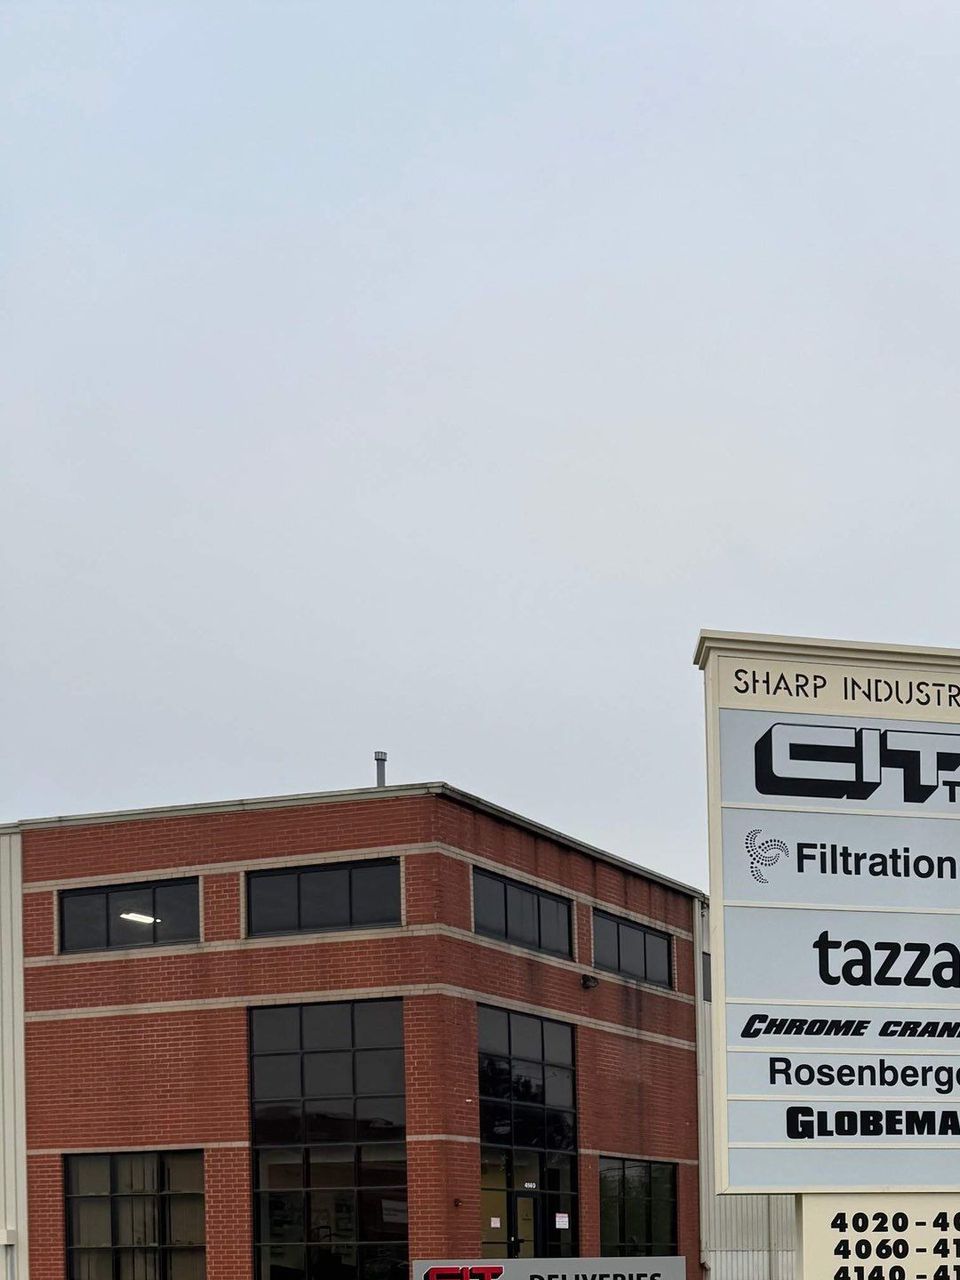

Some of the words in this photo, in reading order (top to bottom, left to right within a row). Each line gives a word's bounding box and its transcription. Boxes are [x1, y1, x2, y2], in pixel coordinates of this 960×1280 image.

[733, 668, 828, 699] SHARP
[796, 842, 957, 880] Filtration
[740, 1013, 871, 1039] CHROME
